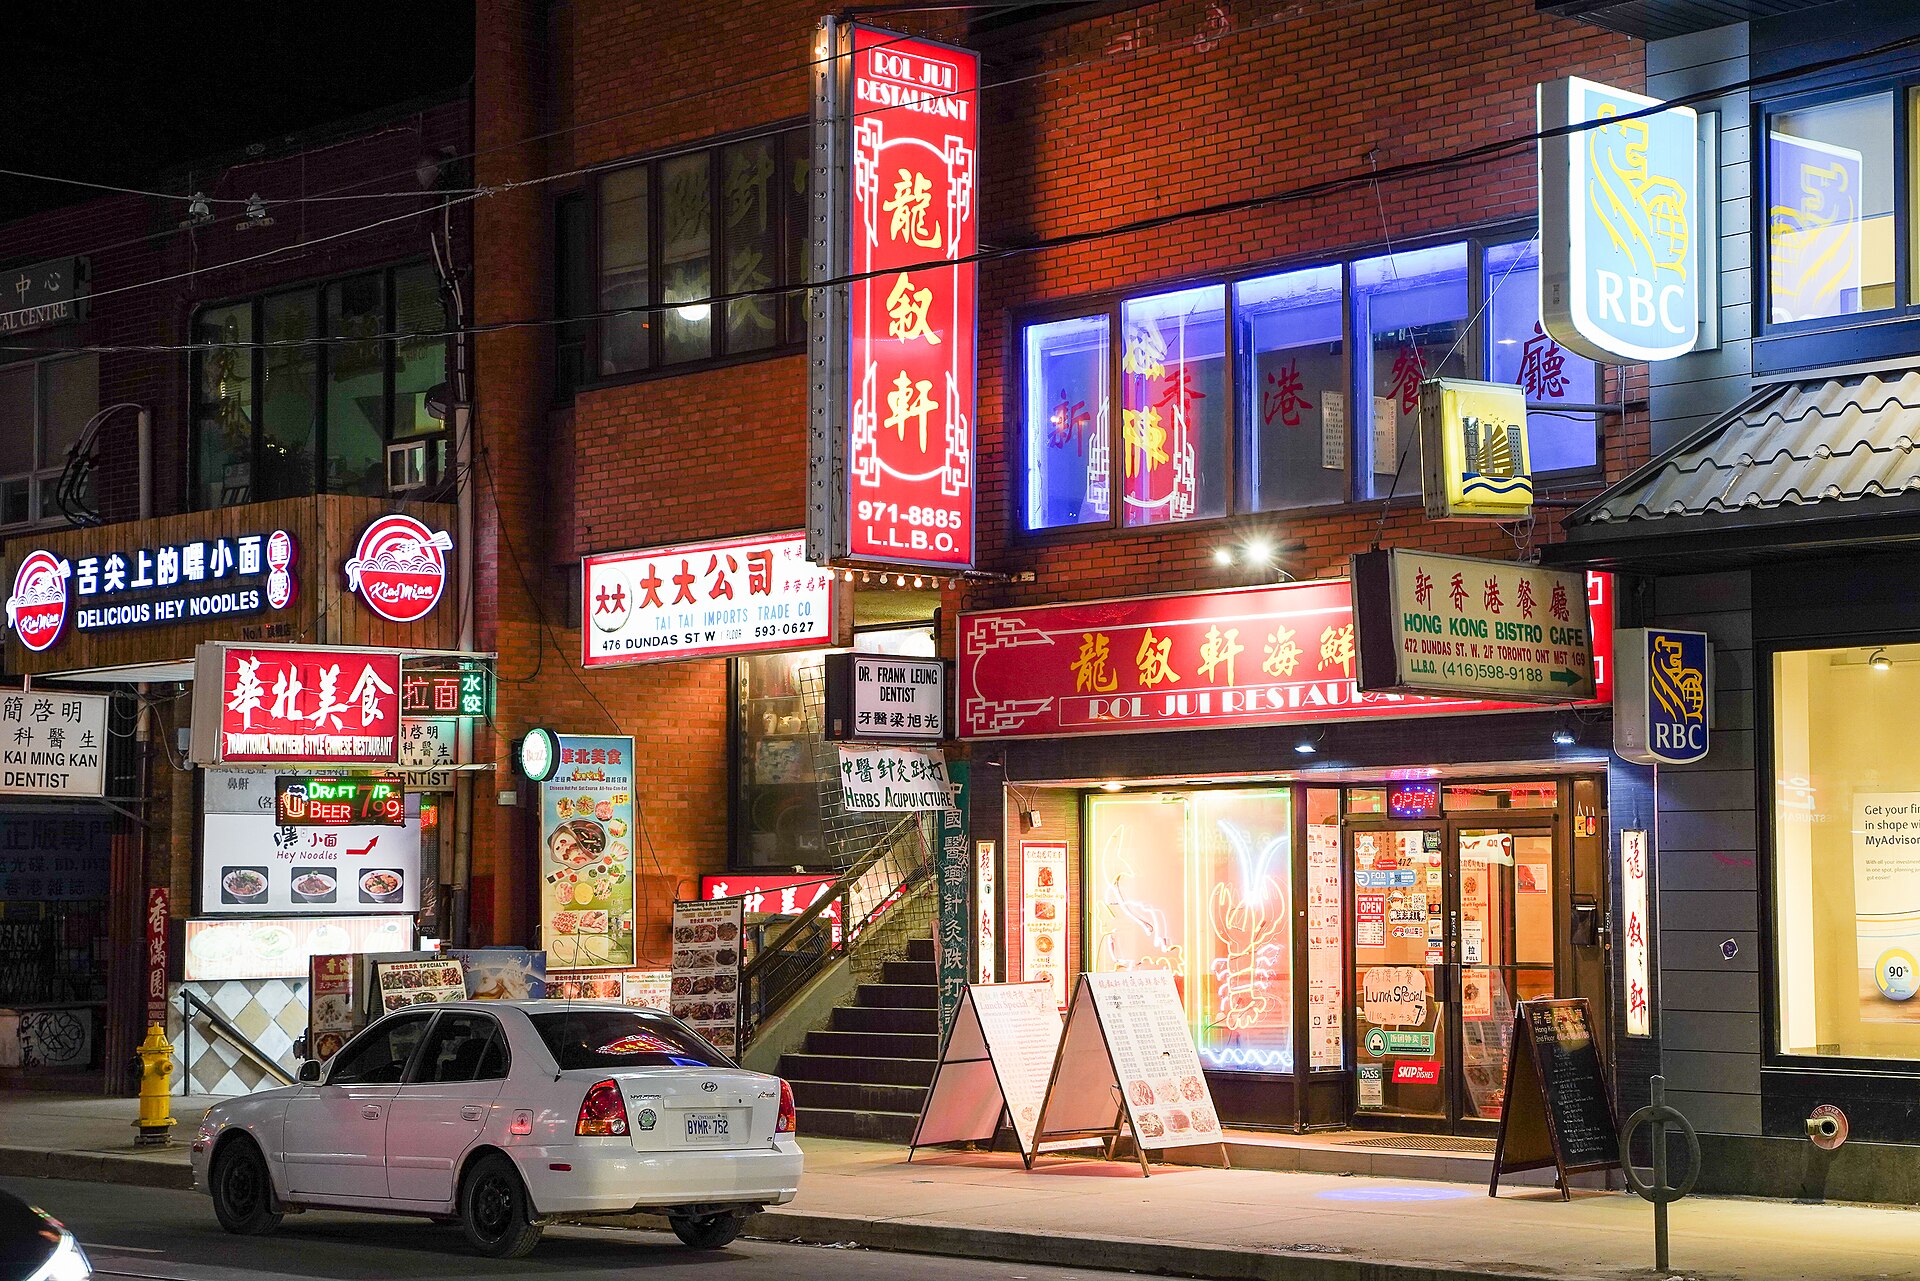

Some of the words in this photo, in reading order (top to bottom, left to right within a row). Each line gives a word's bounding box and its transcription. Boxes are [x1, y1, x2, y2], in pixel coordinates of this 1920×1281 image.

[874, 51, 916, 81] ROL
[919, 62, 952, 89] JUI
[857, 77, 970, 121] RESTAURANT
[1596, 268, 1687, 335] RBC
[20, 303, 68, 326] CENTRE
[857, 499, 962, 529] 971-8885
[866, 524, 960, 553] L.L.B.O.
[77, 535, 262, 596] 舌尖上的嘿小面
[639, 549, 774, 609] 大大公司
[1414, 566, 1571, 623] 新香港餐廳
[77, 604, 151, 629] DELICIOUS
[155, 599, 185, 621] HEY
[190, 590, 260, 617] NOODLES
[655, 615, 671, 631] TAI
[678, 613, 695, 629] TAI
[703, 607, 748, 626] IMPORTS
[758, 603, 791, 621] TRADE
[602, 639, 621, 651] 476
[625, 634, 679, 649] DUNDAS
[1403, 613, 1443, 635] HONG
[1449, 617, 1488, 639] KONG
[1494, 621, 1543, 644] BISTRO
[1549, 625, 1584, 647] CAFE
[1404, 638, 1418, 654] 472
[1421, 640, 1452, 657] DUNDAS
[1483, 645, 1494, 660] 2/F
[1496, 645, 1532, 663] TORONTO
[1535, 649, 1550, 664] ONT
[1553, 651, 1568, 666] M5T
[858, 666, 873, 683] DR.
[877, 667, 907, 684] FRANK
[910, 669, 938, 686] LEUNG
[1410, 658, 1437, 675] L.L.B.O.
[1442, 661, 1544, 683] (416)598-9188
[225, 655, 396, 733] 華北美食
[402, 675, 460, 710] 拉面
[462, 674, 482, 713] 水饺
[880, 686, 917, 703] DENTIST
[1088, 697, 1151, 720] ROL
[1156, 691, 1214, 716] JUI
[858, 711, 940, 729] 牙醫梁旭光
[305, 734, 326, 756] STYLE
[353, 736, 394, 757] RESTAURANT
[1655, 722, 1702, 750] RBC
[4, 750, 27, 765] KAI
[30, 751, 65, 767] MING
[69, 753, 98, 768] KAN
[4, 771, 70, 789] DENTIST
[1391, 791, 1436, 809] OPEN
[1864, 805, 1883, 815] Get
[1885, 806, 1908, 818] your
[1864, 820, 1875, 830] in
[1877, 819, 1909, 833] shape
[276, 850, 297, 863] Hey
[299, 850, 338, 861] Noodles
[1360, 901, 1382, 913] OPEN
[979, 1001, 1003, 1010] Lunch
[1003, 999, 1029, 1010] Special
[1361, 1070, 1379, 1079] PASS
[1397, 1066, 1418, 1078] SKIP
[1416, 1071, 1435, 1079] DISHES
[687, 1120, 709, 1135] BYMR
[712, 1119, 729, 1134] 752
